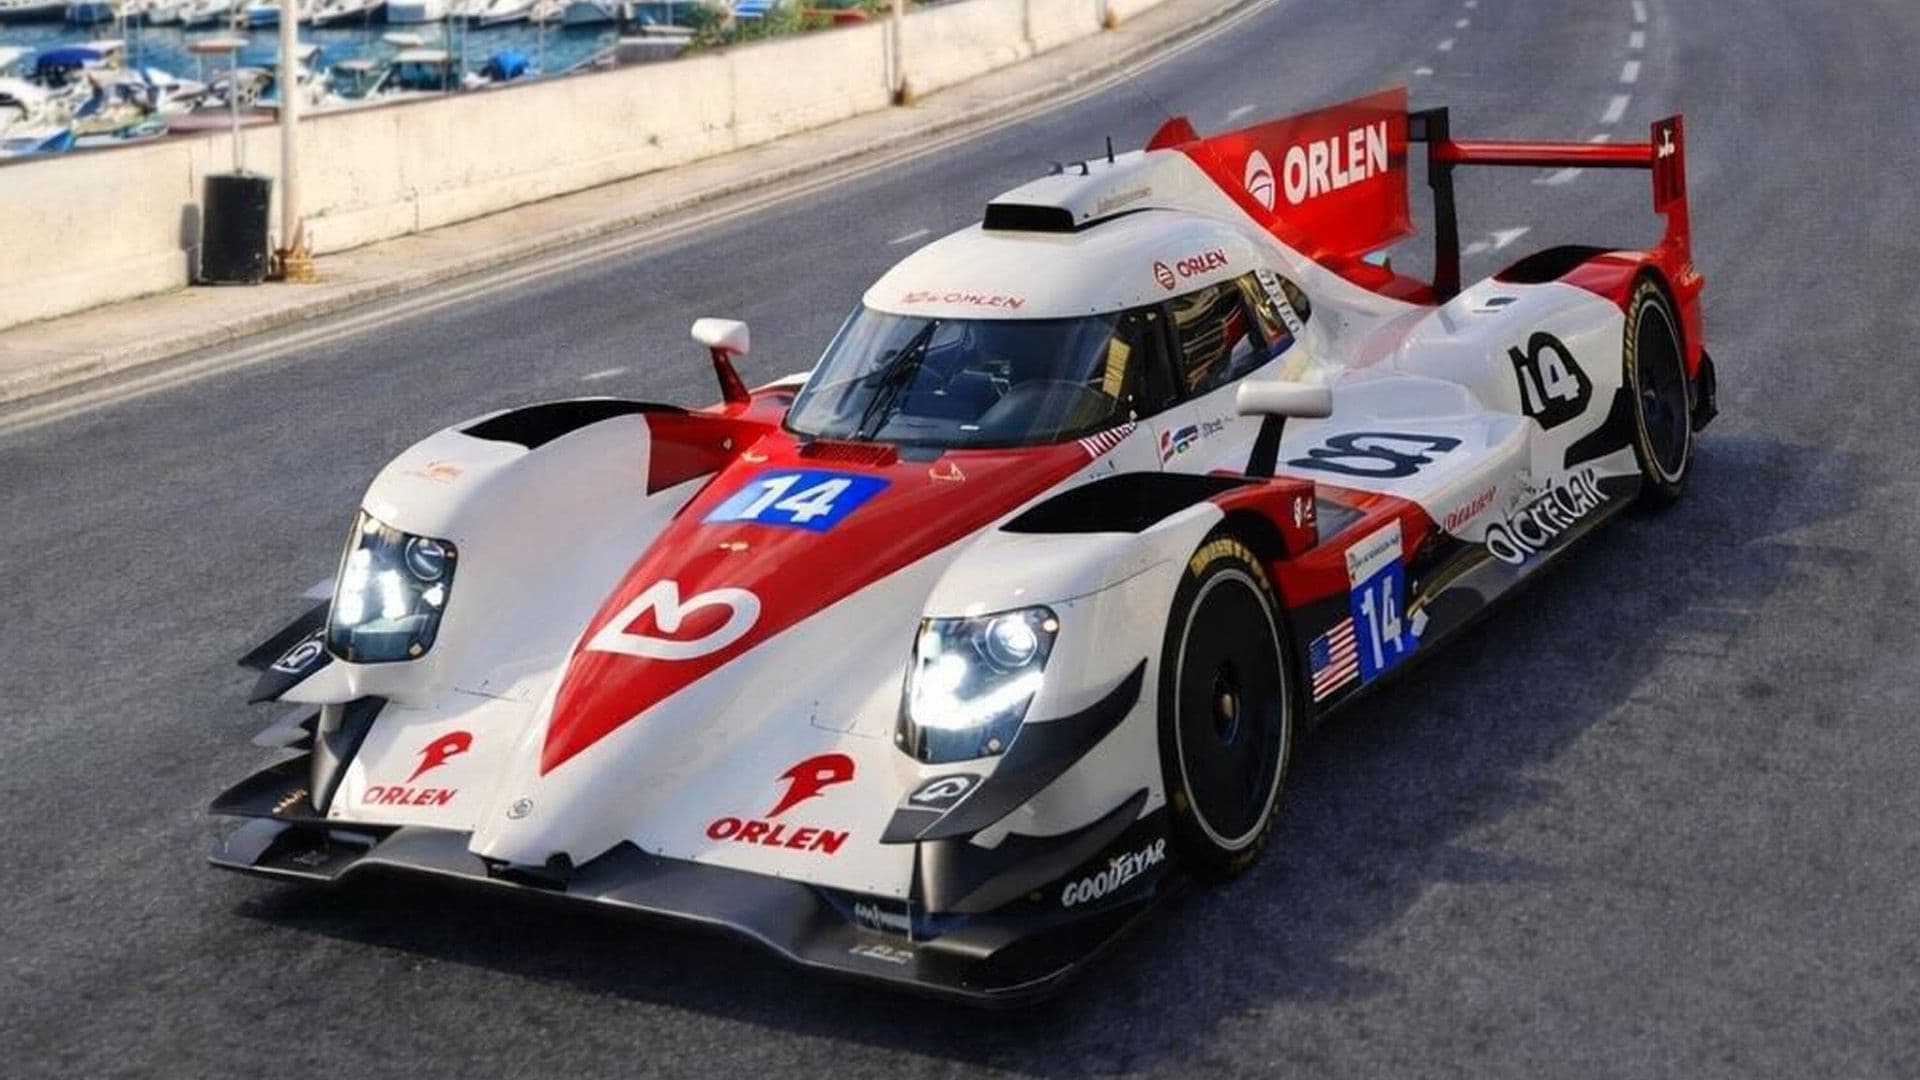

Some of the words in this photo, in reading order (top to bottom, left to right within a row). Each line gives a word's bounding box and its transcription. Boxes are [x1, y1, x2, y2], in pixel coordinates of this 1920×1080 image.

[1283, 121, 1388, 205] ORLEN
[1176, 249, 1227, 278] ORLEN
[736, 474, 852, 522] 14
[1361, 575, 1403, 669] 14
[362, 786, 458, 806] ORLEN
[706, 817, 850, 855] ORLEN
